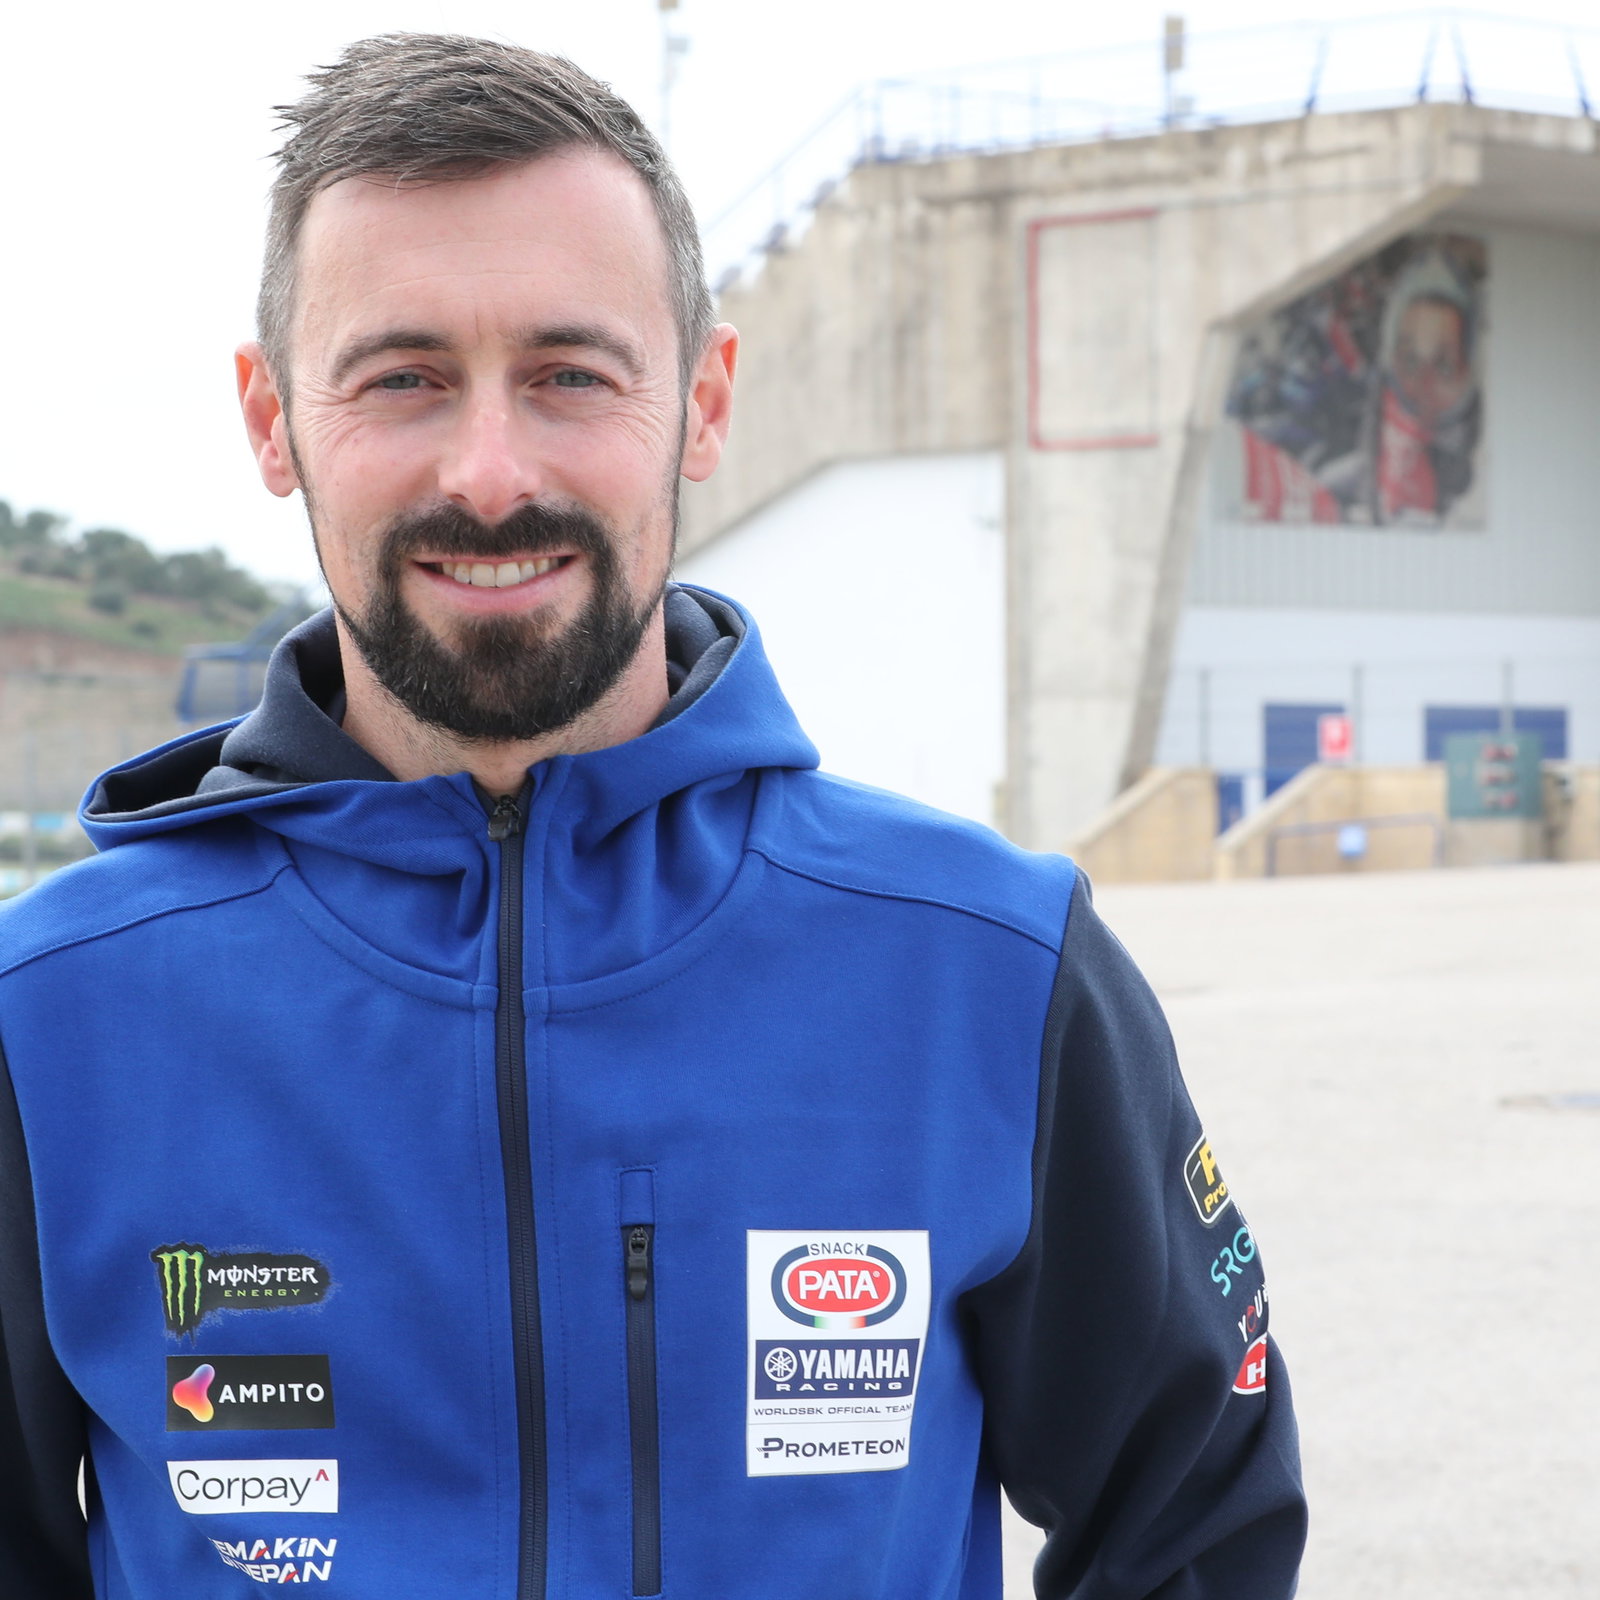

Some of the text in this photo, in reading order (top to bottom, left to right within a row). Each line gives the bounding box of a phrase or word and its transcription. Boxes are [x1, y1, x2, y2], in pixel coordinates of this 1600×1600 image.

[809, 1242, 864, 1256] SNACK
[1210, 1226, 1256, 1297] SRG
[207, 1264, 319, 1287] MONSTER
[798, 1270, 879, 1300] PATA
[224, 1288, 300, 1298] ENERGY
[798, 1348, 910, 1380] YAMAHA
[218, 1383, 325, 1404] AMPITO
[775, 1382, 903, 1392] RACING
[753, 1407, 824, 1416] WORLDSBK
[828, 1405, 882, 1414] OFFICIAL
[756, 1437, 906, 1459] PROMETEON
[176, 1469, 311, 1506] Corpay
